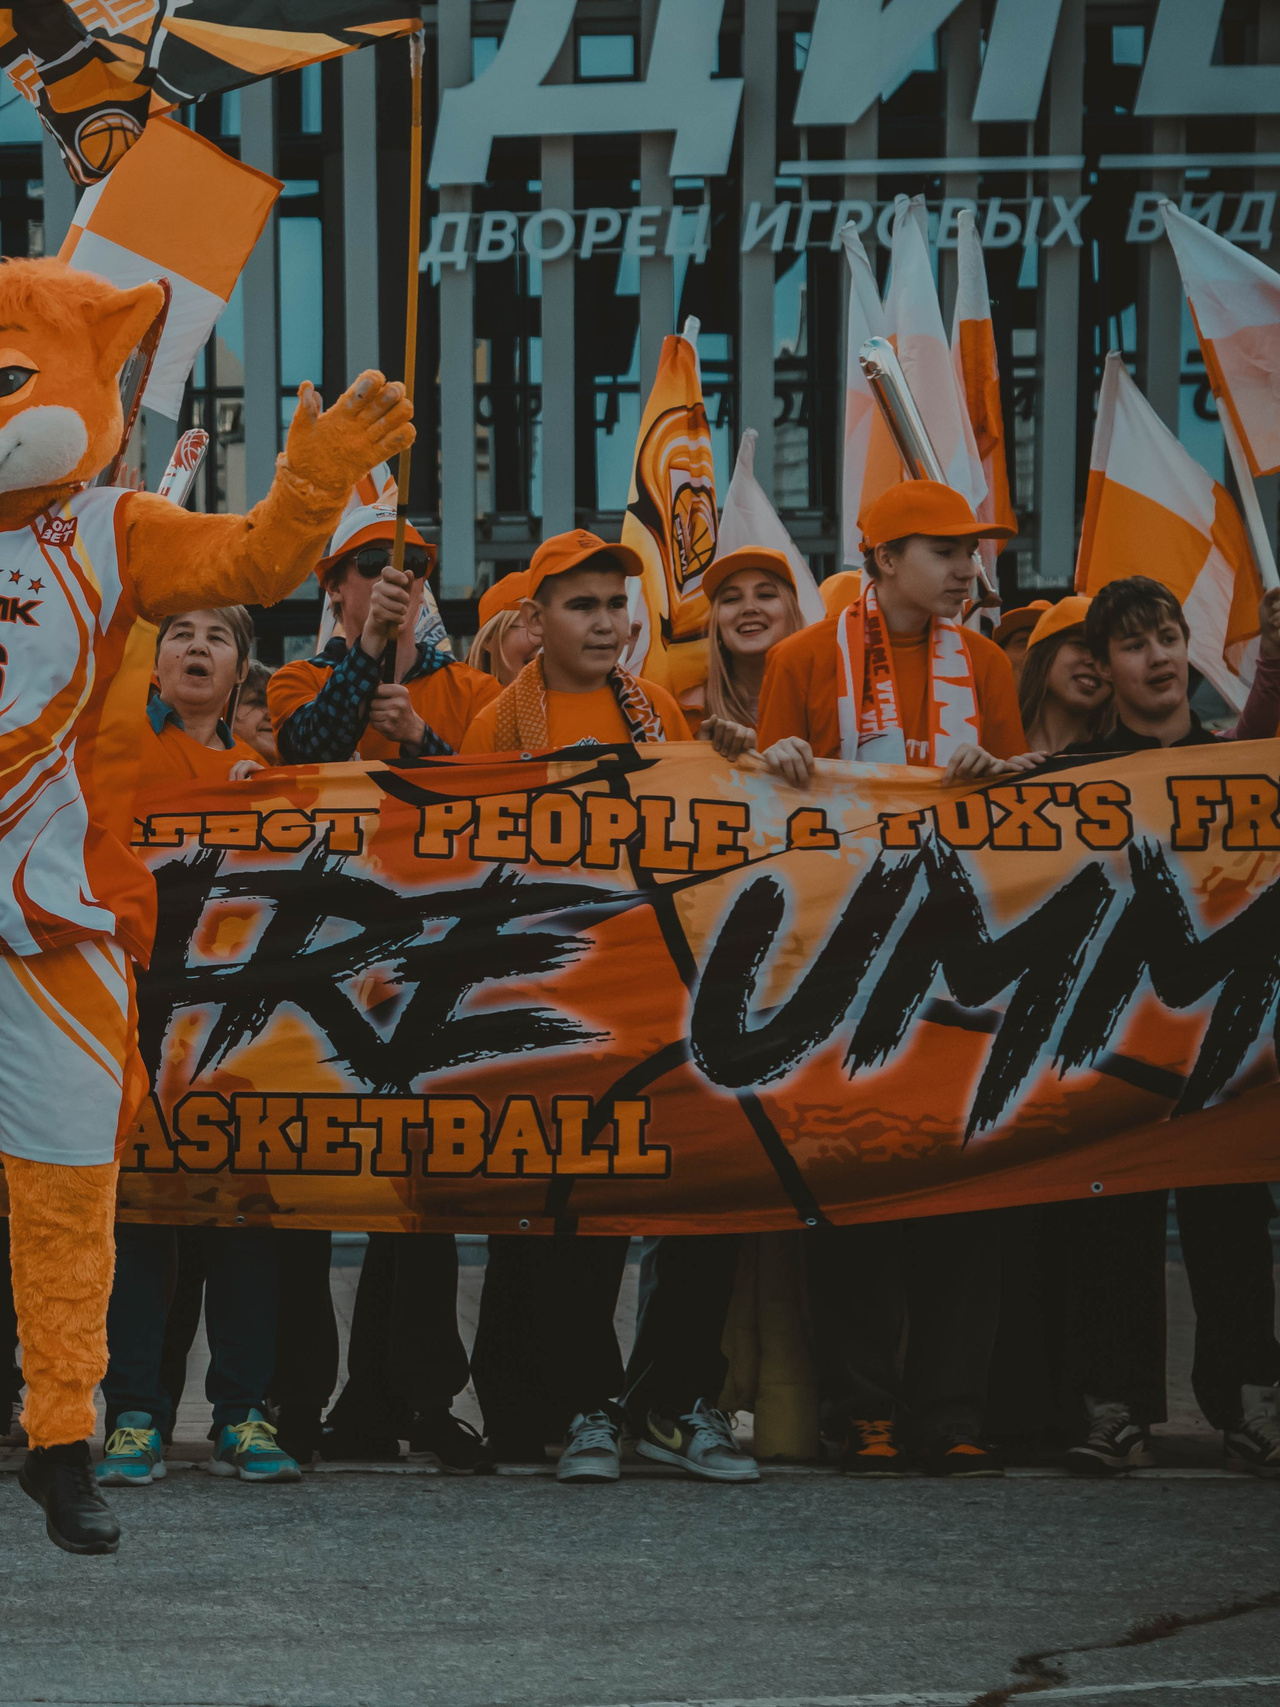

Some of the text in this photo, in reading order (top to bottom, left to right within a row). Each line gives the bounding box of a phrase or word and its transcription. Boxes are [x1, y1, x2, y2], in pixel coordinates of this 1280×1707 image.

[419, 204, 711, 272] ДВОРЕЦ
[41, 529, 74, 543] BET
[52, 520, 75, 532] ON
[414, 789, 751, 873] PEOPLE
[115, 1090, 672, 1179] ASKETBALL
